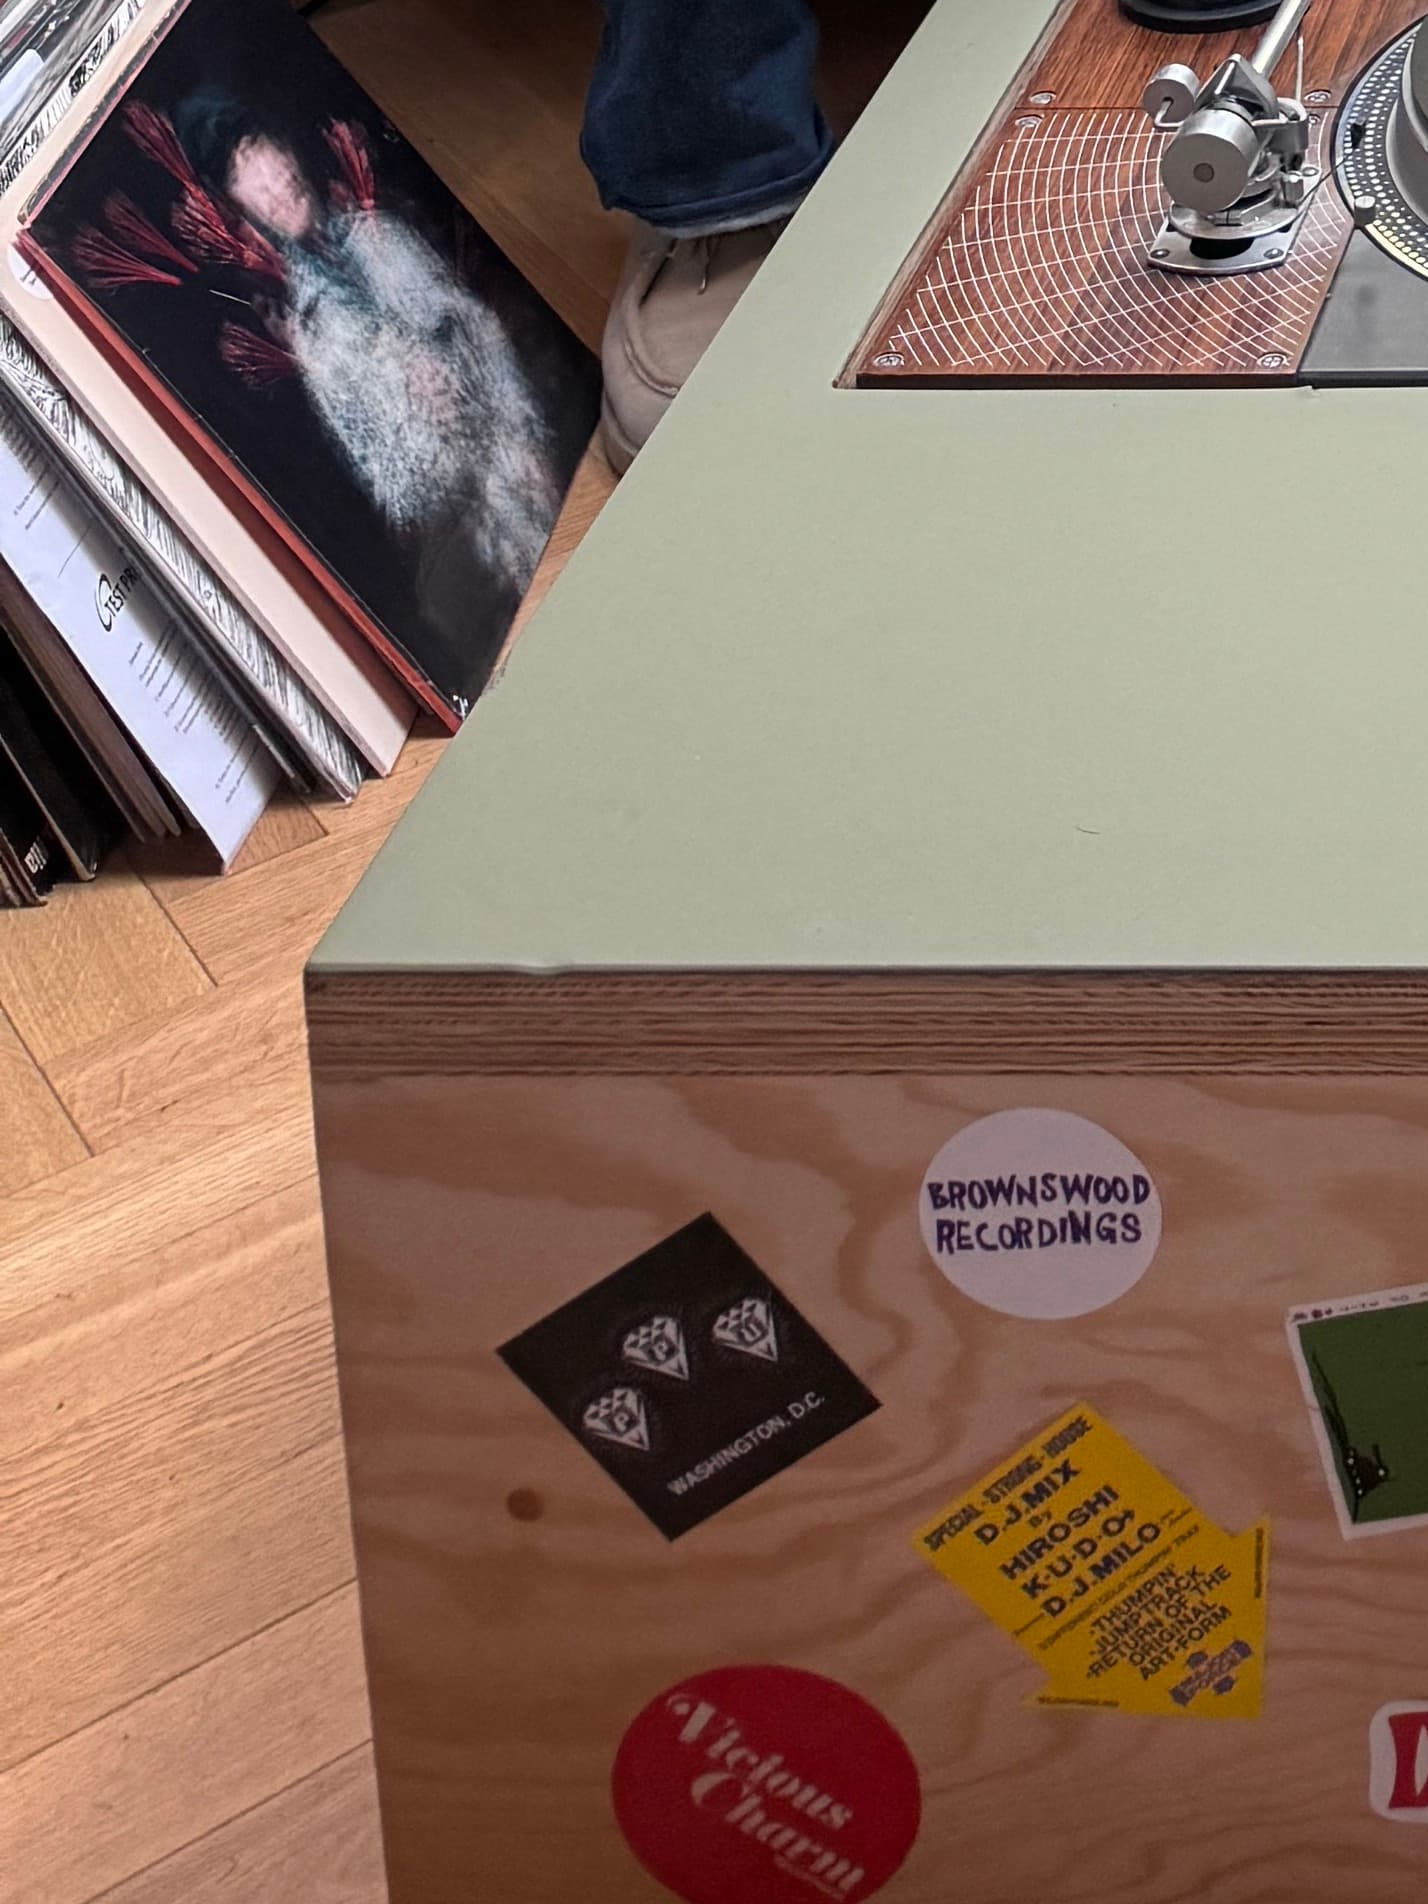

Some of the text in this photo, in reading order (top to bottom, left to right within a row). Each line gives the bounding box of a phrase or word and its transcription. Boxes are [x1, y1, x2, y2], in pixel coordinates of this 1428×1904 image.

[104, 582, 127, 617] TEST
[927, 1172, 1151, 1211] BROWNSWOOD
[936, 1209, 1142, 1255] RECORDINGS
[786, 1391, 826, 1440] D.C.
[1000, 1484, 1120, 1580] HIROSHI
[1164, 1600, 1190, 1621] OF
[1190, 1563, 1233, 1597] THE
[1129, 1598, 1218, 1667] ORIGINAL
[666, 1693, 854, 1830] Vicious
[689, 1769, 865, 1898] Charm
